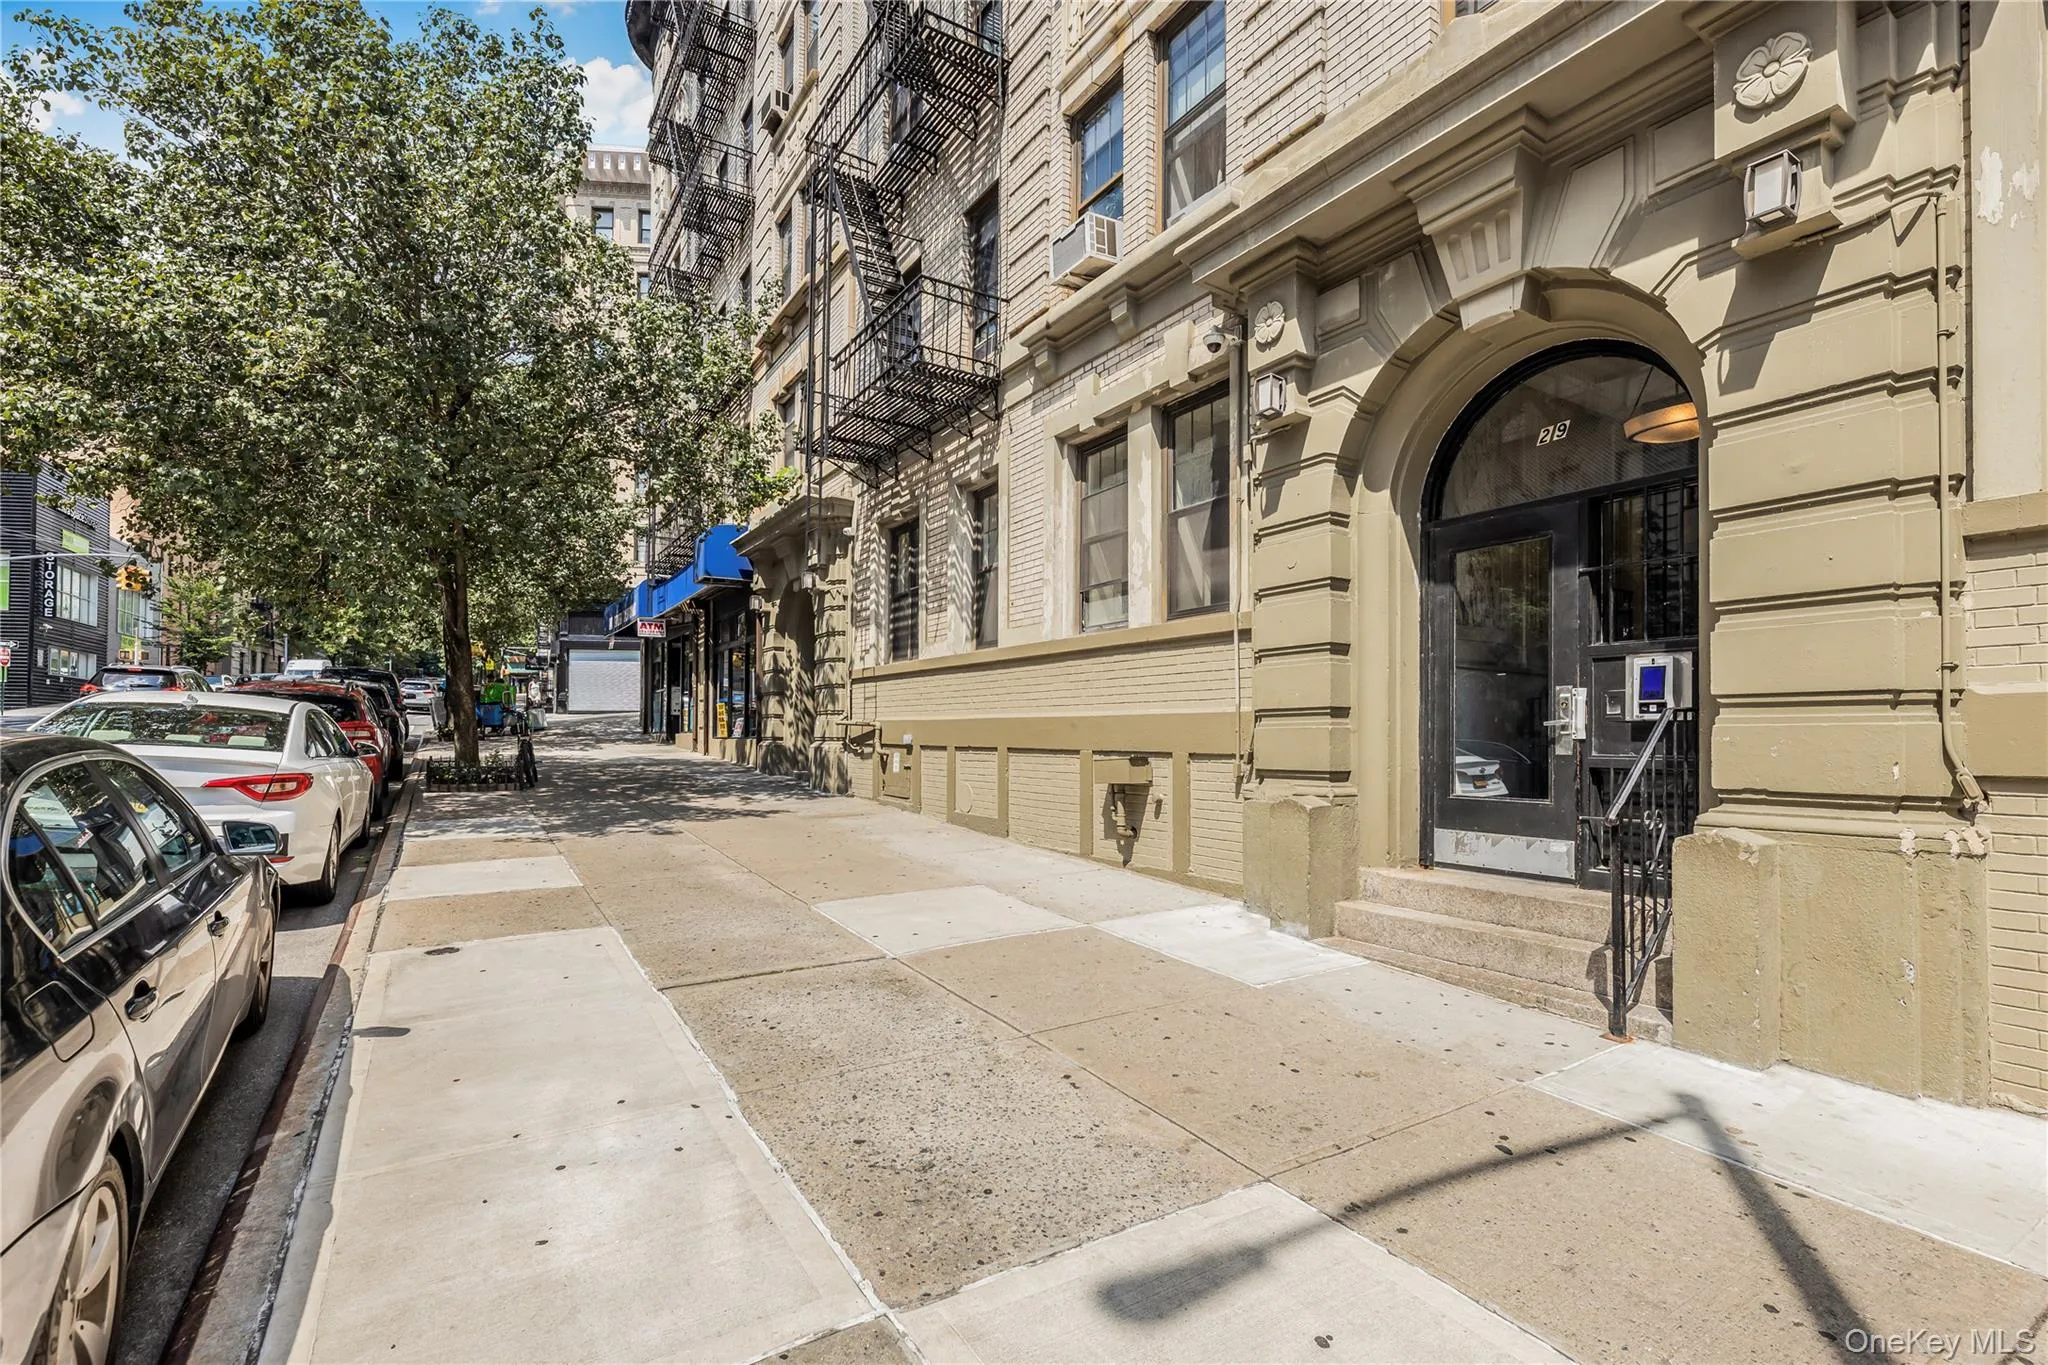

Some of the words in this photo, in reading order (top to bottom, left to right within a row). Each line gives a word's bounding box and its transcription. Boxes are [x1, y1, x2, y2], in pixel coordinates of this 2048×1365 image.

[1539, 422, 1568, 444] 29
[44, 552, 55, 617] STORAGE
[640, 622, 664, 631] ATM
